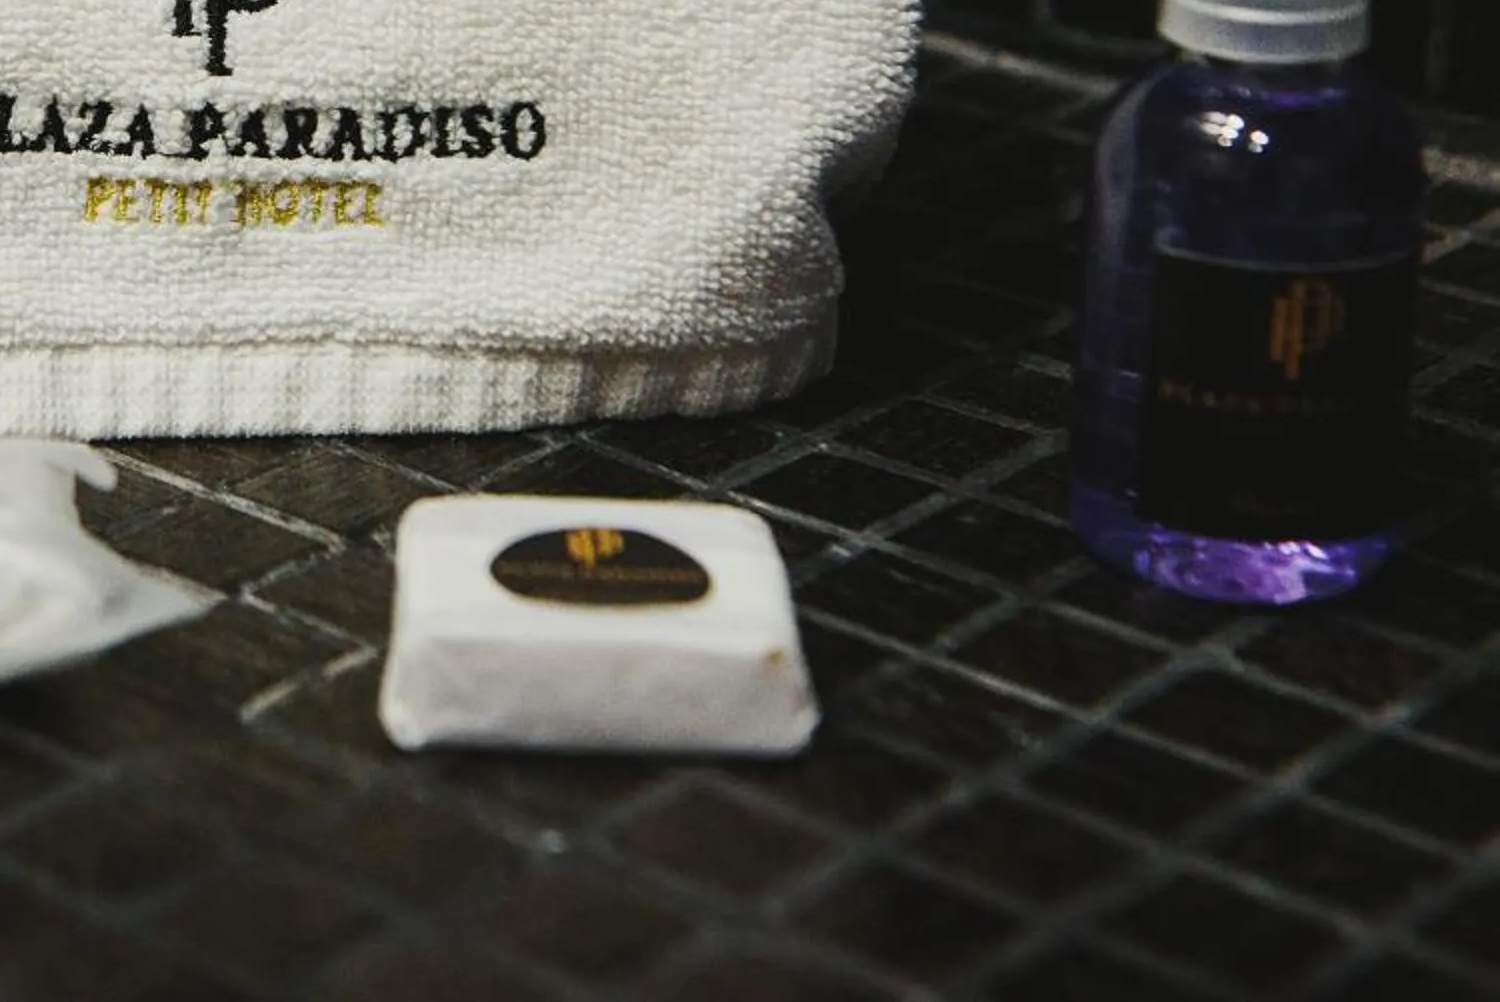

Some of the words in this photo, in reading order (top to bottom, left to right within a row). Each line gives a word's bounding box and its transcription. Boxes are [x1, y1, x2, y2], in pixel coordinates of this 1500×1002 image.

[188, 101, 547, 162] PARADISO
[83, 176, 213, 225] PETIT
[233, 176, 386, 227] HOTEL
